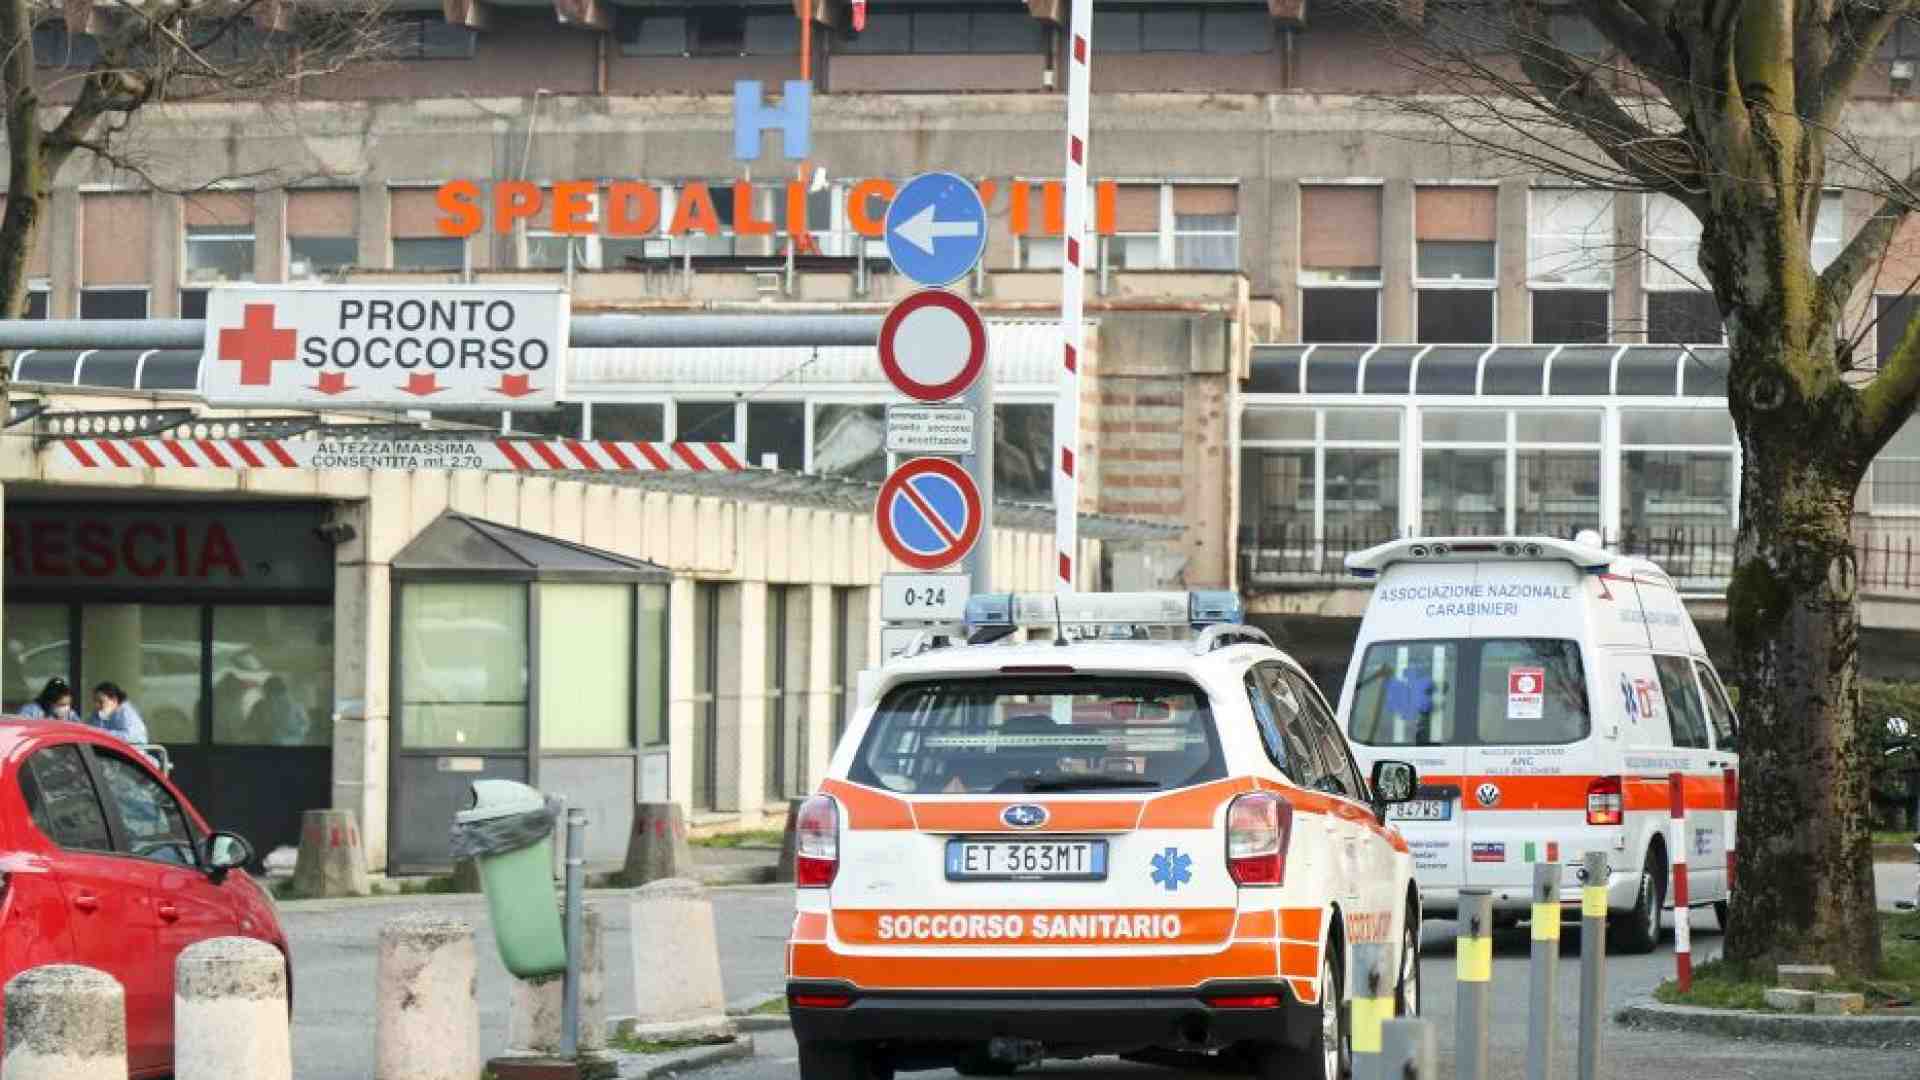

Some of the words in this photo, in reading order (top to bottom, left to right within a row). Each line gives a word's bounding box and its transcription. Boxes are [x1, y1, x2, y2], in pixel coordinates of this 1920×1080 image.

[434, 179, 806, 237] SPEDALI
[847, 179, 1116, 236] CILI
[339, 300, 516, 332] PRONTO
[302, 337, 549, 370] SOCCORSO
[317, 441, 390, 454] ALTEZZA
[397, 441, 476, 454] MASSIMA
[312, 455, 418, 468] CONSENTITA
[451, 456, 483, 468] 2.70
[905, 587, 945, 606] 0-24
[1380, 585, 1483, 601] ASSOCIAZIONE
[1487, 583, 1572, 599] NAZIONALE
[1426, 602, 1518, 617] CARABINIERI
[965, 845, 996, 871] ET
[1007, 845, 1087, 871] 363MT
[877, 913, 1023, 939] SOCCORSO
[1031, 913, 1182, 939] SANITARIO
